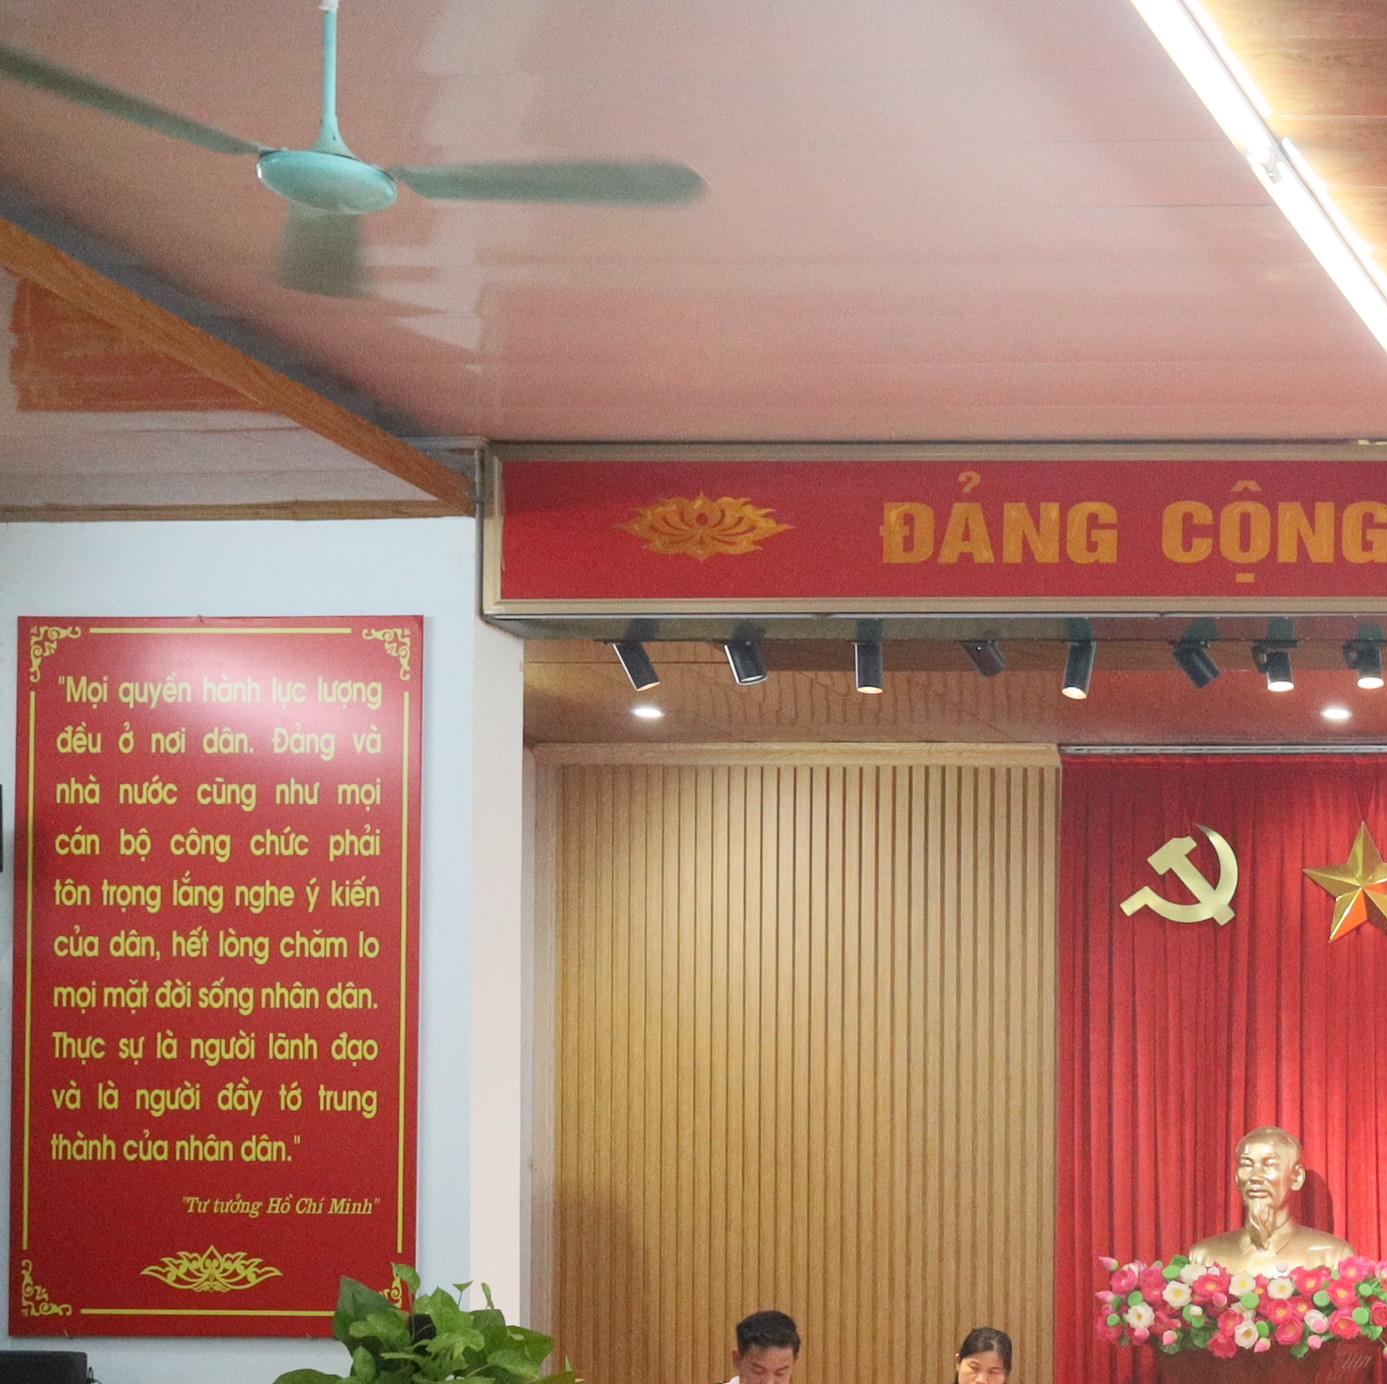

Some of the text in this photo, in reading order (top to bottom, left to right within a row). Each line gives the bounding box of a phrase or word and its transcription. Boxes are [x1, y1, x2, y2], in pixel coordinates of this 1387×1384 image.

[879, 472, 1117, 564] ĐẢNG
[57, 776, 100, 803] nhà
[120, 777, 178, 804] nước
[277, 780, 319, 804] như
[338, 779, 380, 809] mọi
[56, 826, 380, 862] cán bộ công chức phải
[55, 872, 379, 913] tôn trọng lắng nghe ý kiến
[54, 926, 379, 964] của dân, hết lòng chăm lo
[54, 980, 378, 1014] mọi mặt đời sống nhân dân.
[54, 1031, 379, 1065] Thực sự là người lãnh đạo
[52, 1078, 377, 1118] và là người đầy tớ trung
[51, 1131, 300, 1161] thành của nhân dân."
[182, 1193, 381, 1218] "Tư tưởng Hồ Chí Minh"
